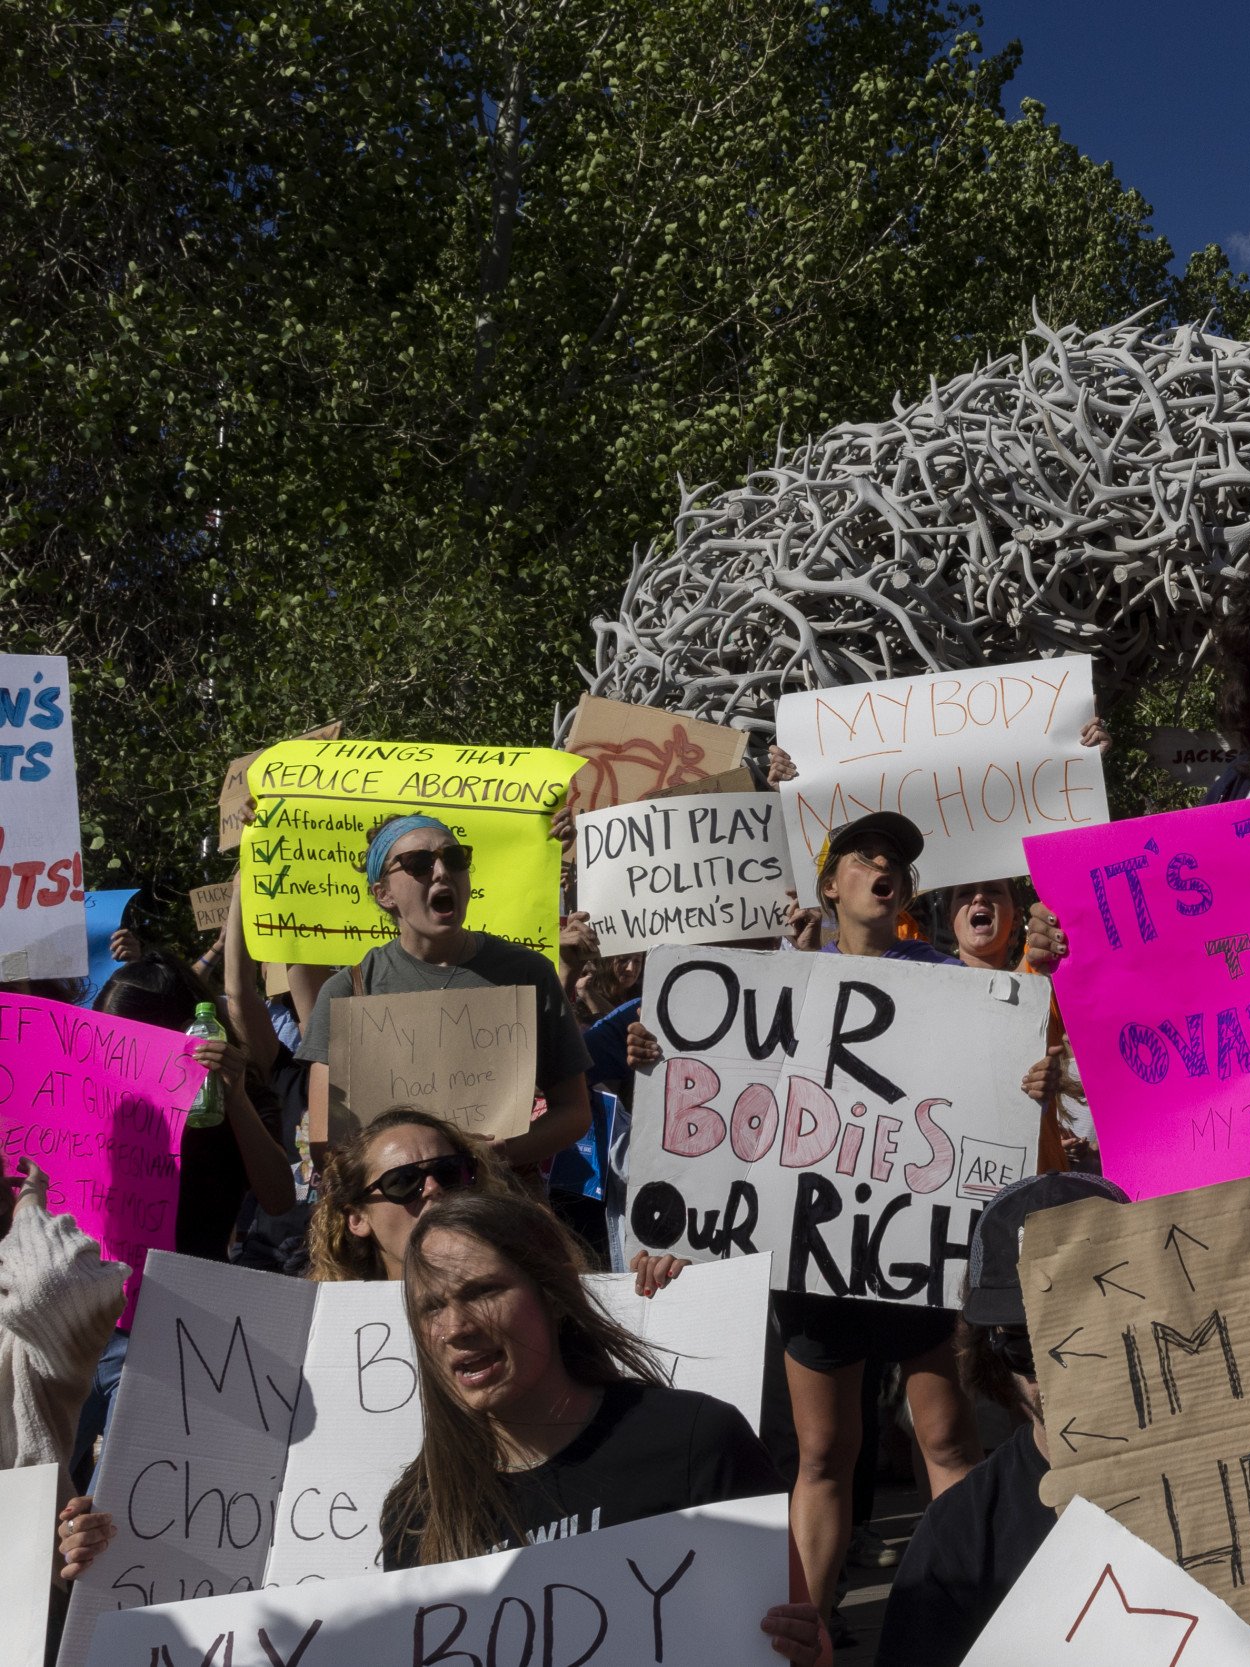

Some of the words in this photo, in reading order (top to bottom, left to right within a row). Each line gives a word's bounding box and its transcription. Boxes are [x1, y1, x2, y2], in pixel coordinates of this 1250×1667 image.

[815, 685, 913, 756] MY
[931, 670, 1070, 737] BODY
[315, 741, 435, 763] THINGS
[455, 748, 531, 768] THAT
[261, 761, 384, 794] REDUCE
[398, 770, 565, 808] ABORTIONS
[897, 757, 1094, 838] CHOICE
[276, 809, 365, 833] Affordable
[584, 804, 679, 869] DON'T
[688, 803, 773, 845] PLAY
[196, 888, 231, 904] FUCK
[277, 873, 360, 904] Investing
[626, 856, 783, 898] POLITICS
[1090, 837, 1213, 950] IT'S
[278, 912, 327, 940] Men
[588, 914, 617, 936] ITH
[621, 895, 735, 939] WOMEN'S
[50, 1010, 150, 1082] WOMAN
[158, 1052, 194, 1093] IS
[360, 1006, 415, 1064] My
[439, 1003, 528, 1049] Mom
[32, 1071, 73, 1107] AT
[389, 1068, 438, 1099] had
[449, 1069, 496, 1090] more
[0, 1123, 93, 1160] ECOMES
[1191, 1104, 1235, 1152] MY
[964, 1156, 1015, 1188] ARE
[1121, 1309, 1244, 1430] IM
